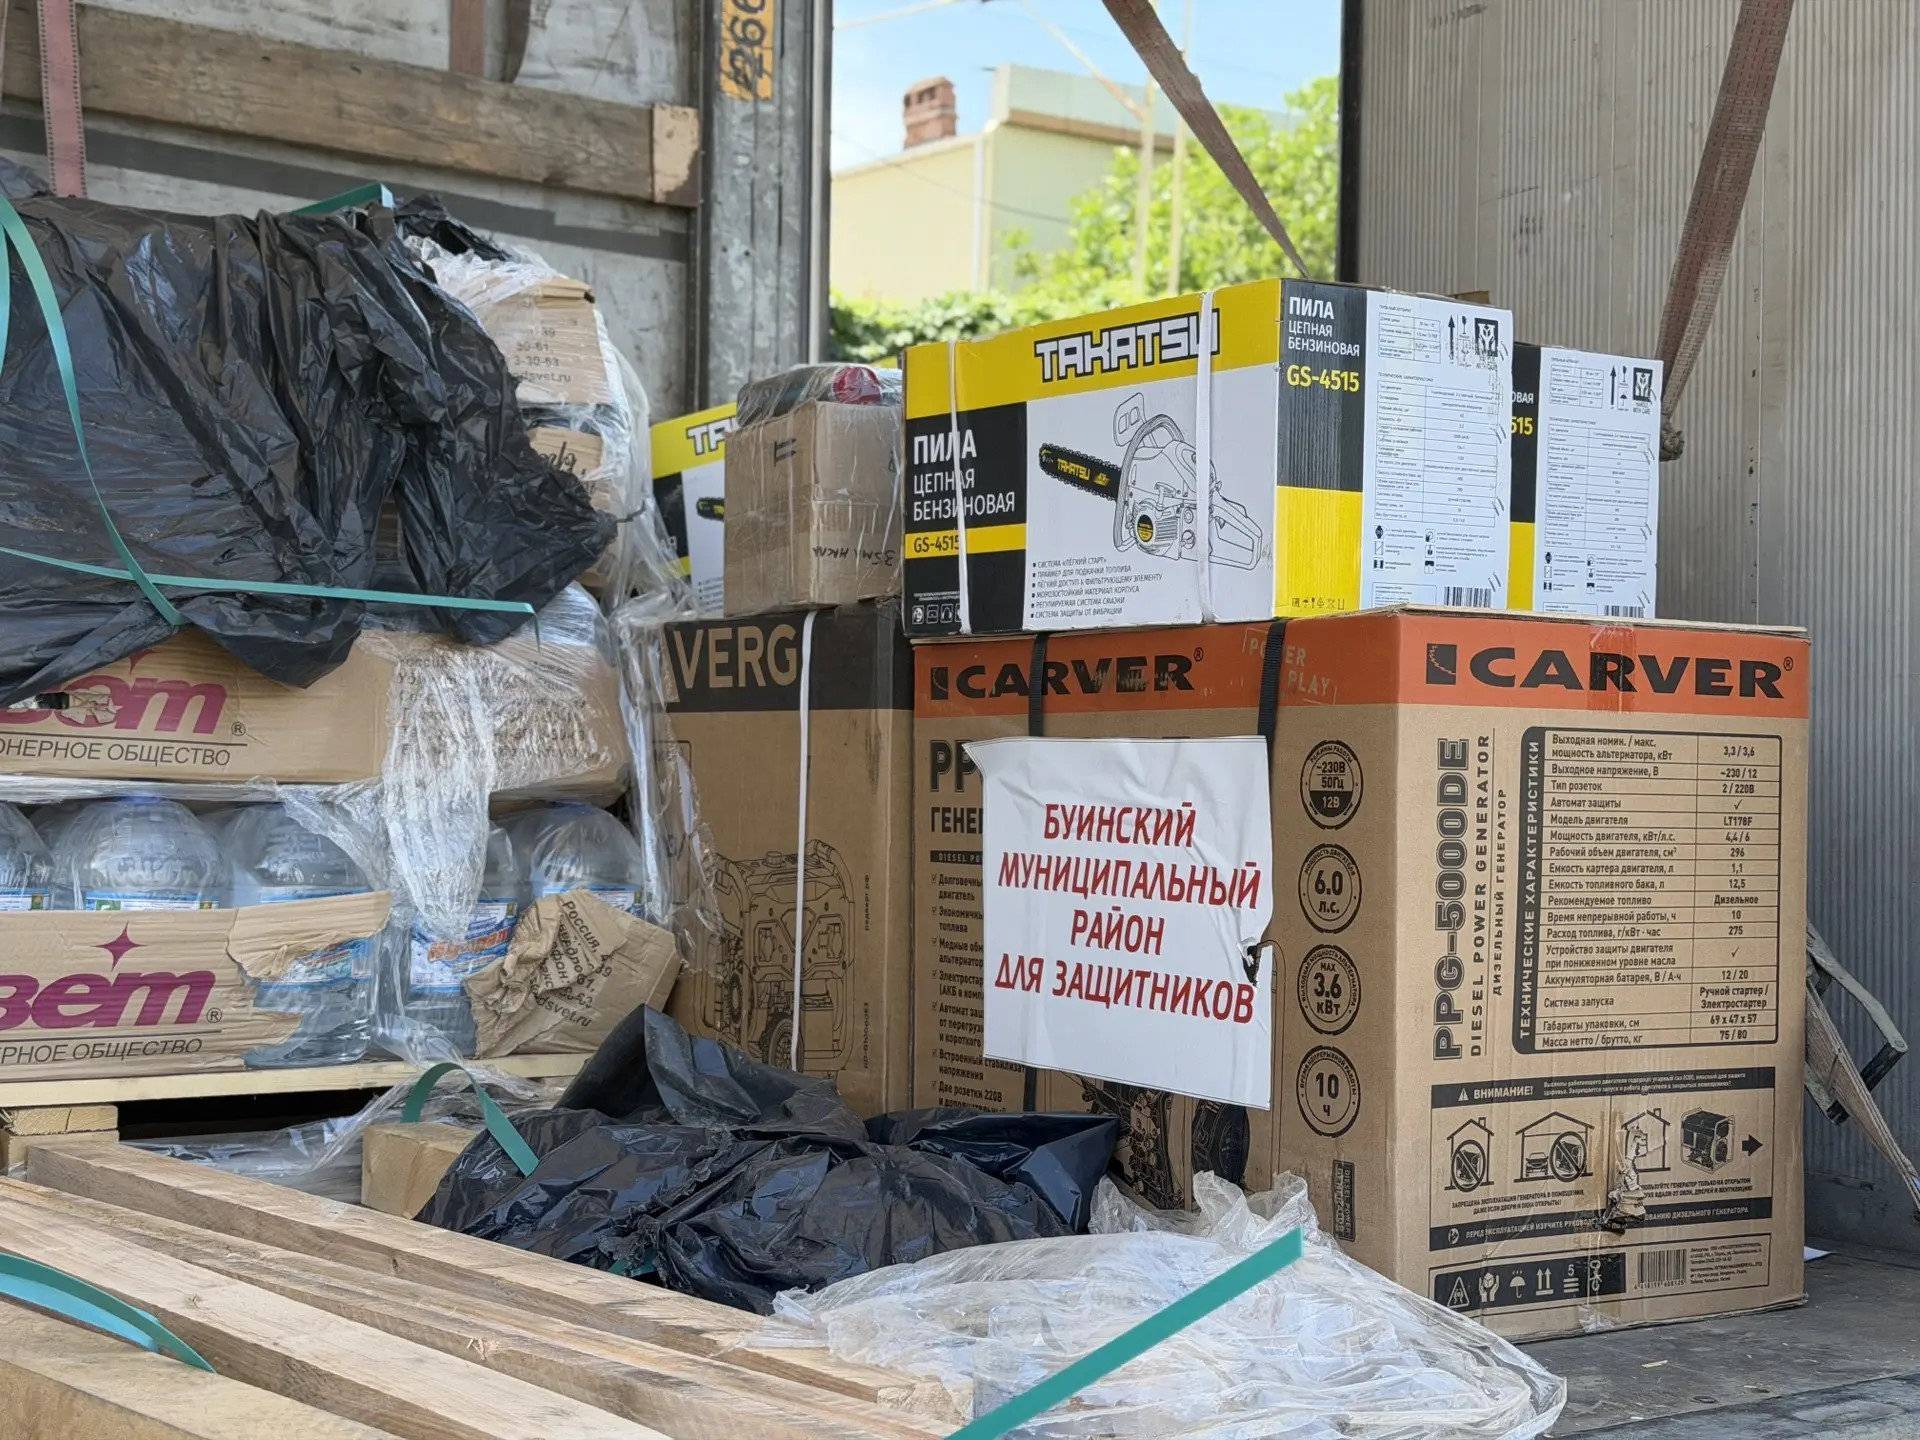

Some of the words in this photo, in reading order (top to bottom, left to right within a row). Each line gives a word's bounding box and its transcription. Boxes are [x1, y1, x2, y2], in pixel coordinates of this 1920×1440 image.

[1289, 296, 1334, 320] ПИЛА
[1288, 320, 1332, 338] ЦЕПНАЯ
[1288, 337, 1360, 357] БЕНЗИНОВАЯ
[1286, 364, 1360, 393] GS-4515
[1288, 670, 1330, 695] PLAY
[1552, 734, 1595, 746] Выходная
[1597, 737, 1627, 746] номин.
[1635, 738, 1656, 747] макс.
[107, 742, 231, 767] ОБЩЕСТВО
[1552, 749, 1594, 759] мощность
[1552, 765, 1594, 776] Выходное
[1597, 766, 1651, 778] напряжение,
[1321, 777, 1344, 789] 50Гц
[1551, 781, 1566, 791] Тип
[1568, 781, 1602, 792] розеток
[1476, 735, 1490, 872] GENERATOR
[1550, 798, 1585, 808] Автомат
[1588, 799, 1621, 809] защиты
[1044, 802, 1197, 848] БУИНСКИЙ
[1525, 741, 1539, 905] ХАРАКТЕРИСТИКИ
[1550, 814, 1583, 825] Модель
[1585, 816, 1628, 825] двигателя
[1496, 789, 1506, 884] ГЕНЕРАТОР
[1550, 831, 1594, 841] Мощность
[1550, 847, 1585, 857] Рабочий
[1731, 848, 1744, 857] 296
[1550, 862, 1583, 873] Емкость
[1586, 864, 1619, 874] картера
[998, 852, 1261, 910] МУНИЦИПАЛЬНЫЙ
[1315, 870, 1343, 895] 6.0
[1549, 879, 1583, 889] Емкость
[1586, 880, 1633, 891] топливного
[1433, 738, 1469, 1059] PPG-5000DE
[1548, 895, 1615, 906] Рекомендуемое
[1617, 895, 1652, 905] топливо
[1714, 895, 1758, 905] Дизельное
[1473, 883, 1487, 963] POWER
[1548, 912, 1575, 923] Время
[1577, 912, 1634, 923] непрерывной
[563, 901, 600, 953] Россия,
[1070, 906, 1165, 955] РАЙОН
[1547, 928, 1576, 939] Расход
[1728, 926, 1743, 935] 275
[1493, 892, 1504, 995] ДИЗЕЛЬНЫЙ
[1546, 944, 1594, 955] Устройство
[1596, 944, 1628, 954] защиты
[1630, 944, 1673, 953] двигателя
[1545, 960, 1561, 969] при
[1564, 957, 1617, 967] пониженном
[1619, 958, 1649, 968] уровне
[1651, 957, 1675, 965] масла
[1519, 910, 1536, 1040] ТЕХНИЧЕСКИЕ
[1545, 974, 1614, 985] Аккумуляторная
[994, 953, 1044, 993] ДЛЯ
[1052, 959, 1257, 1024] ЗАЩИТНИКОВ
[1314, 972, 1342, 998] 3.6
[1700, 987, 1730, 997] Ручной
[1544, 997, 1581, 1008] Система
[1582, 997, 1614, 1007] запуска
[1471, 975, 1484, 1056] DIESEL
[1543, 1020, 1583, 1031] Габариты
[1630, 1019, 1640, 1027] см
[1543, 1037, 1569, 1047] Масса
[1571, 1036, 1593, 1045] нетто
[72, 1037, 203, 1065] ОБЩЕСТВО
[1316, 1072, 1339, 1099] 10
[1473, 1086, 1533, 1099] ВНИМАНИЕ!
